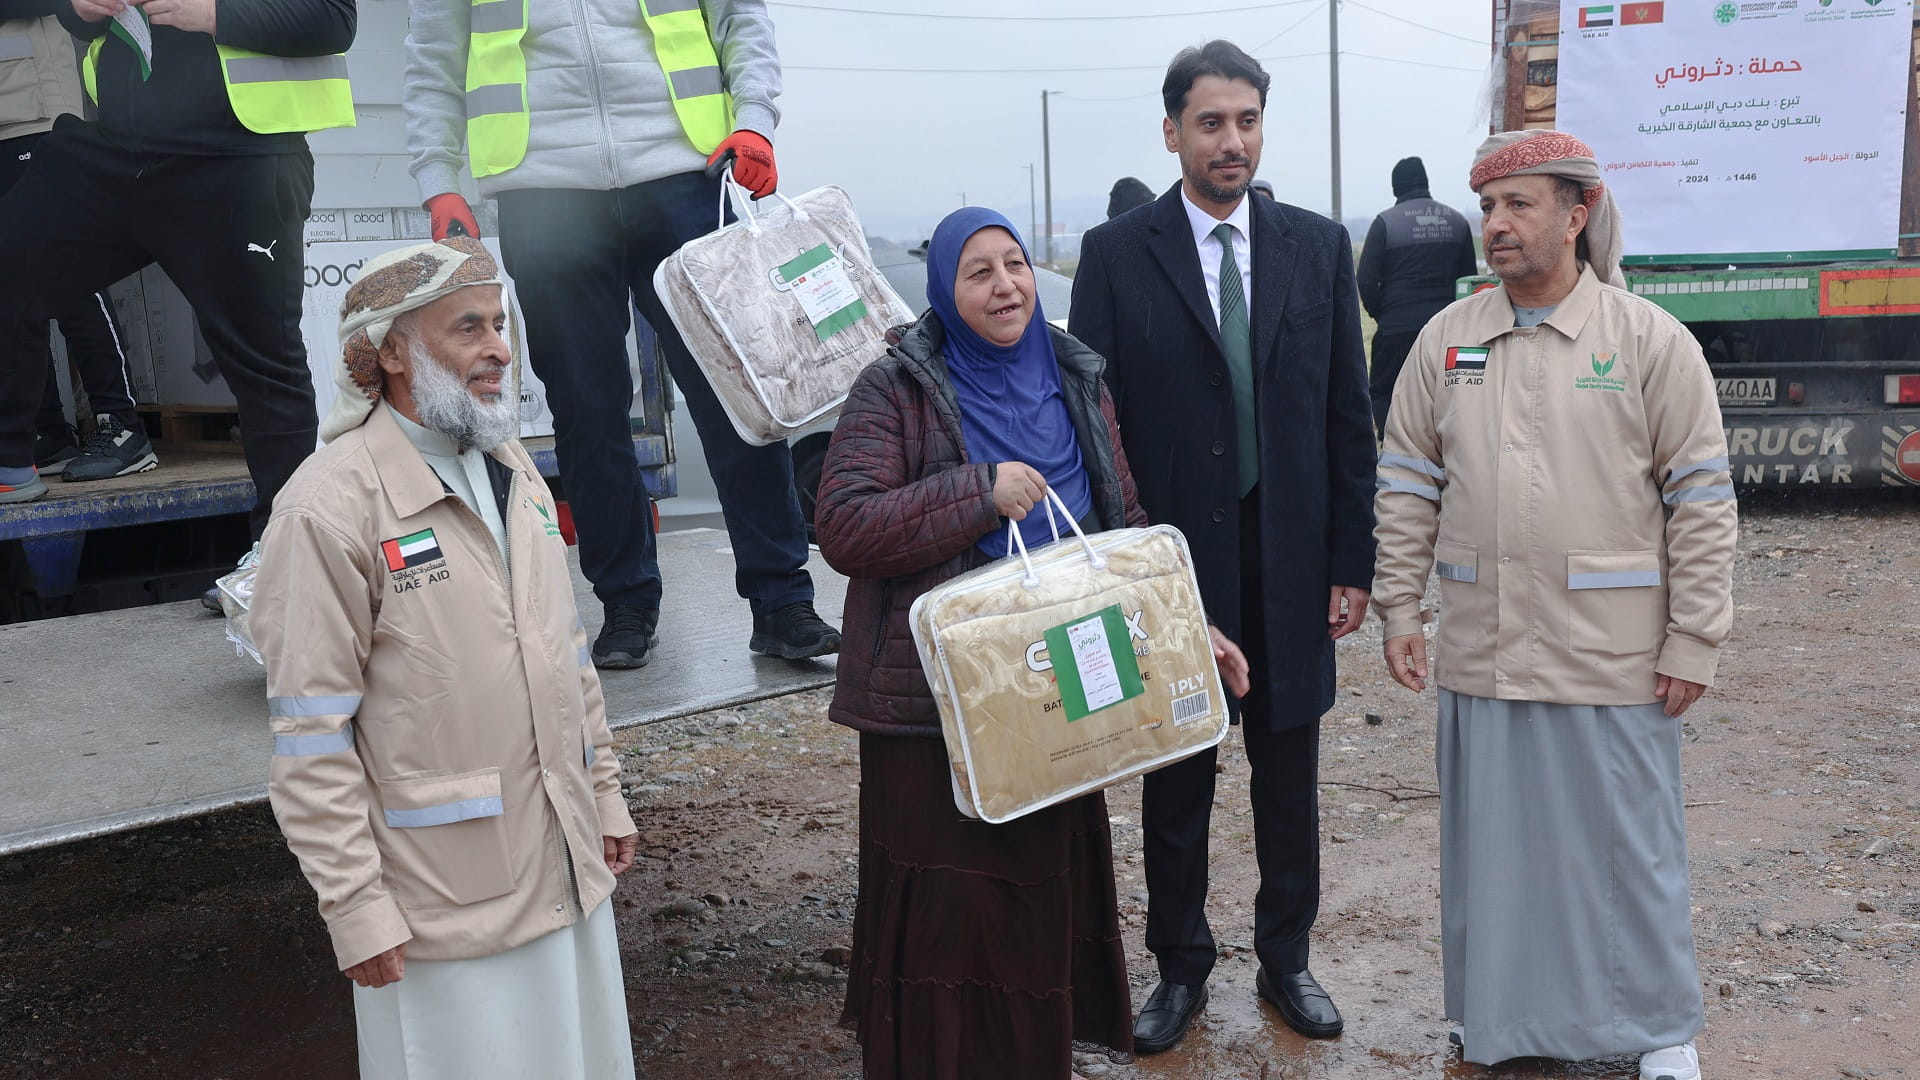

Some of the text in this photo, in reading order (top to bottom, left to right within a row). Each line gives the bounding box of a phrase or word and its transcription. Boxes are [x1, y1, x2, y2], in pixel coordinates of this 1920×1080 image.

[1748, 58, 1802, 74] حملة
[1655, 58, 1733, 88] دثروني
[1660, 101, 1714, 116] الإسلامي
[1716, 101, 1743, 114] دبي
[1745, 98, 1770, 108] بنك
[1780, 96, 1800, 110] تبرع
[1638, 115, 1821, 135] بالتعاون مع جمعية الشارقة الخيرية
[1829, 153, 1849, 162] الجبل
[1855, 151, 1879, 160] الدولة
[1681, 159, 1699, 167] تنفيذ
[1686, 175, 1708, 183] 2024
[1733, 173, 1757, 181] 1446
[1445, 378, 1460, 387] UAE
[394, 570, 450, 594] UAE AID
